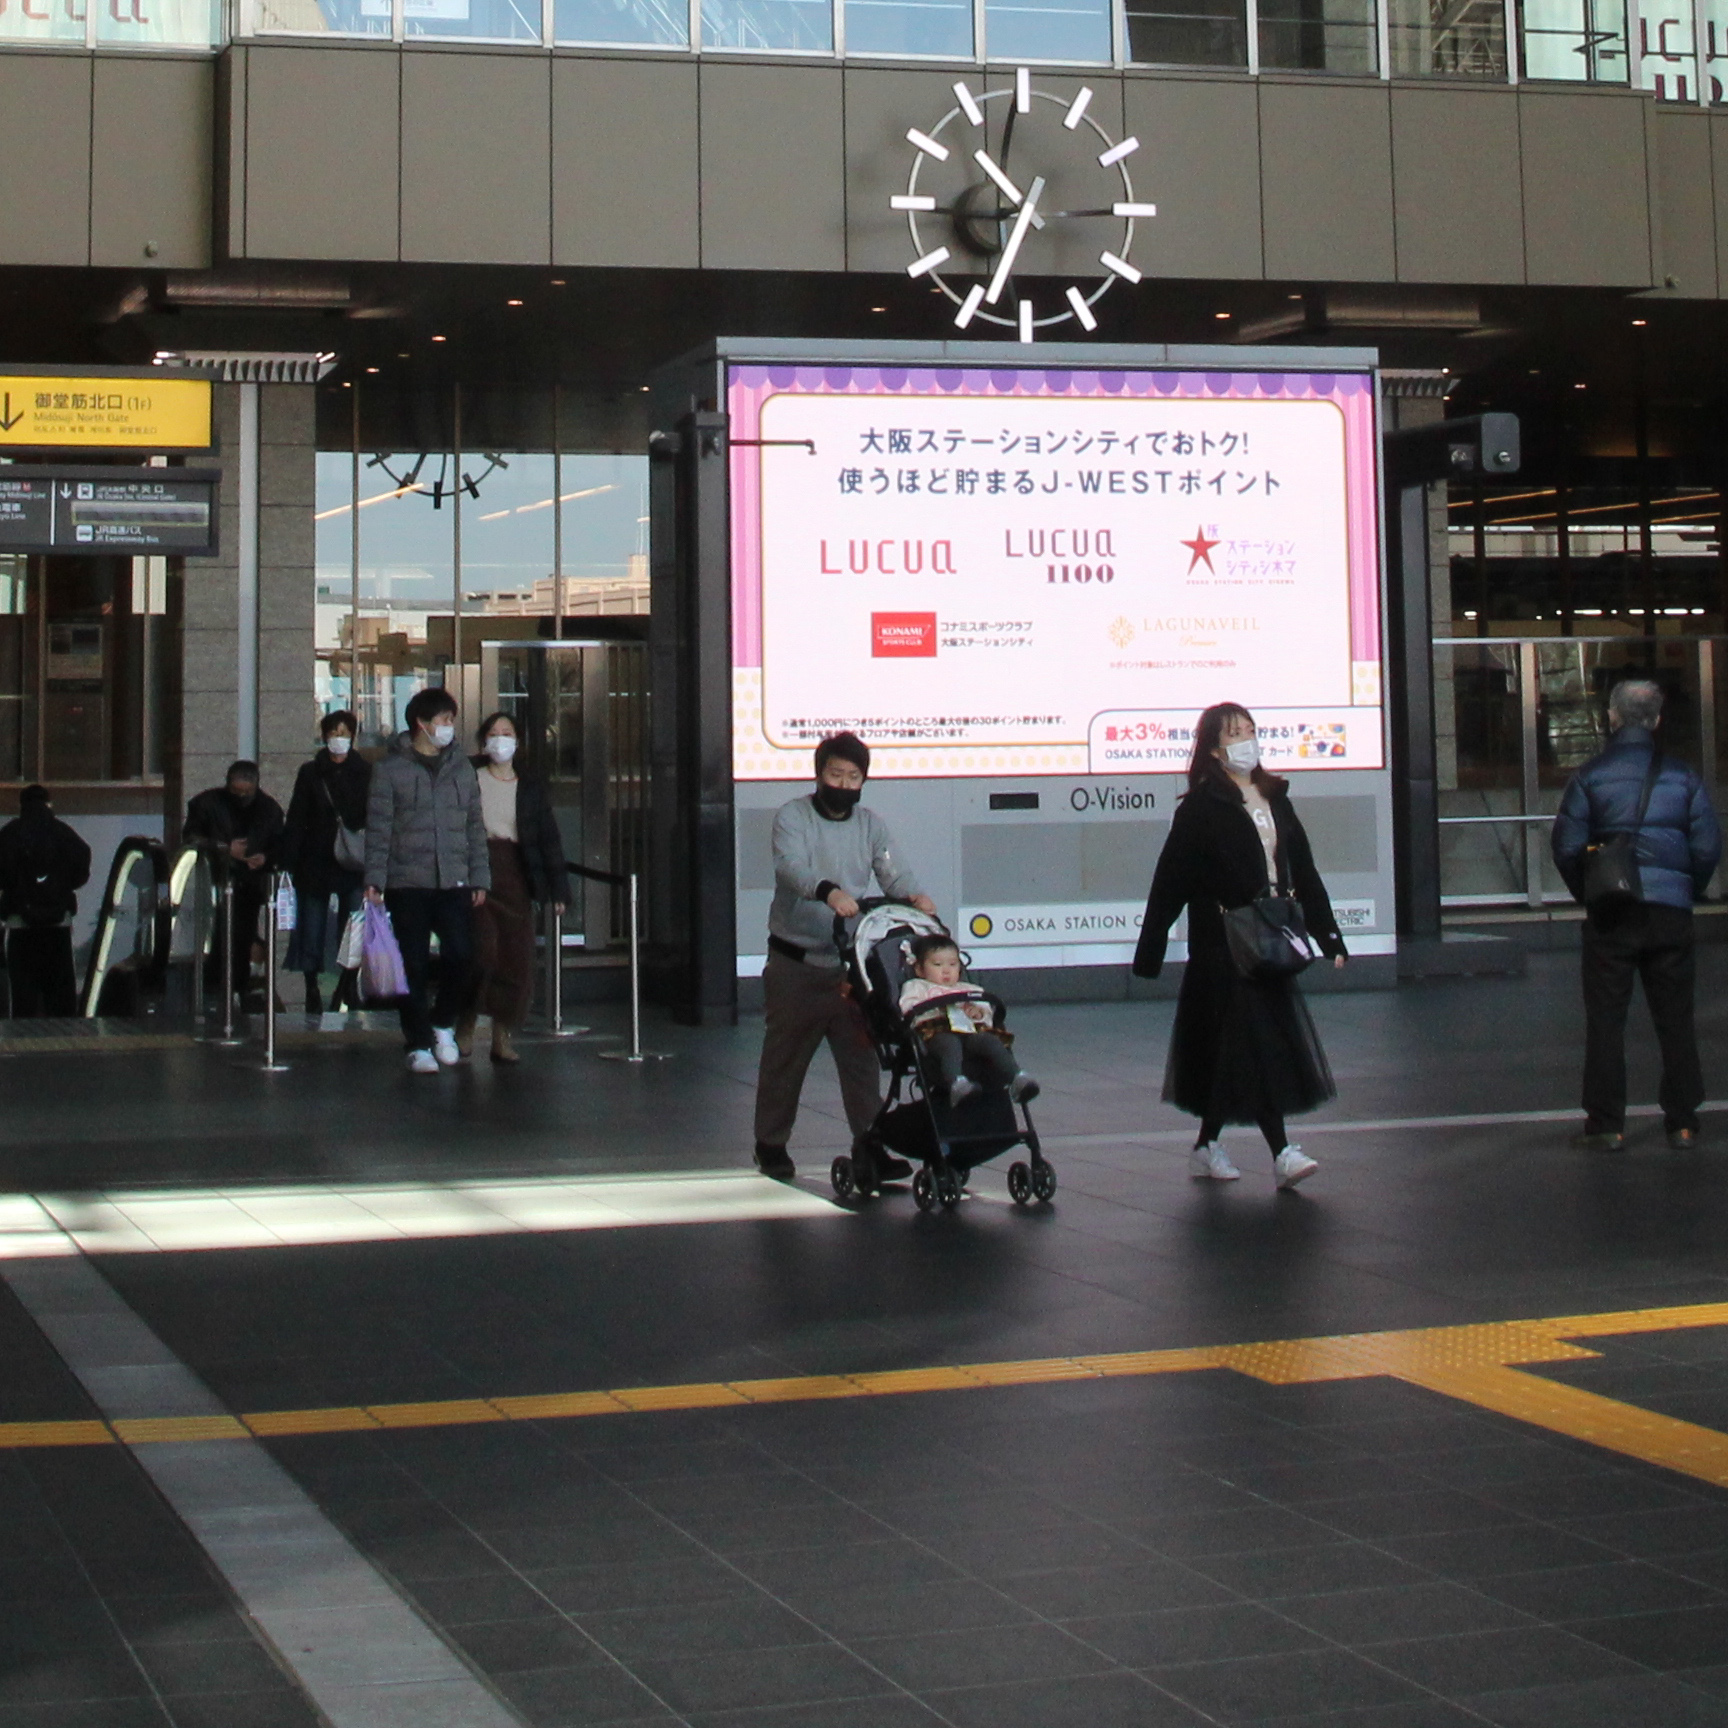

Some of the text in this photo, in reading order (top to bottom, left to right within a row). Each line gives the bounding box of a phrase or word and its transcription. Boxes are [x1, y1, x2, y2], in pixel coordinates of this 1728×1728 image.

[35, 392, 152, 410] 御堂筋北口 (1F)
[77, 412, 104, 422] North
[107, 413, 129, 422] Gate
[859, 427, 1249, 456] 大阪ステーションシティでおトク!
[838, 467, 1281, 496] 使うほど貯まるJ-WESTポイント
[1005, 529, 1117, 557] LUCUA
[1226, 540, 1296, 556] ステーション
[820, 539, 958, 574] LUCUA
[1046, 563, 1114, 584] 1100
[1226, 560, 1296, 575] シティシネマ
[881, 627, 922, 636] KONAMI
[940, 621, 1034, 632] コナミスポーツクラブ
[1143, 618, 1260, 631] LAGUNAVEIL
[940, 638, 1034, 647] 大阪ステーションシティ
[1105, 748, 1143, 759] OSAKA
[1070, 786, 1155, 811] O-Vision
[1004, 917, 1056, 932] OSAKA
[1064, 915, 1127, 930] STATION
